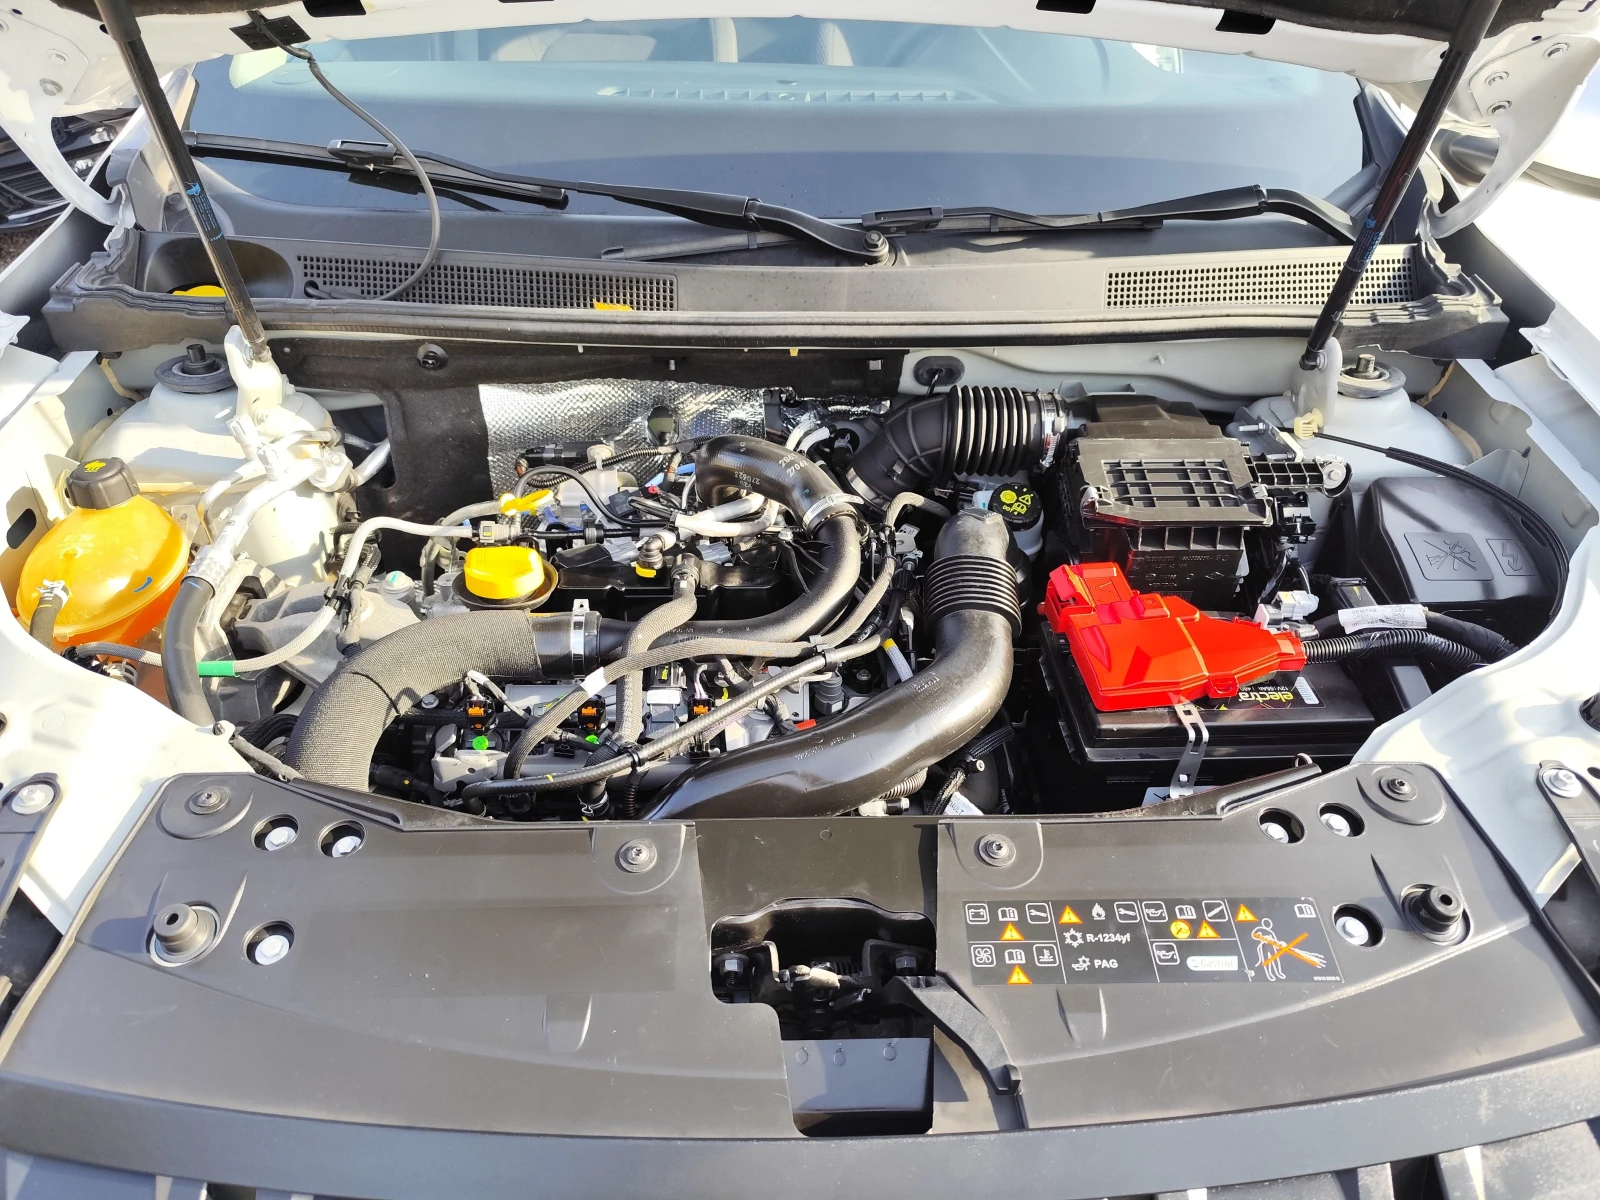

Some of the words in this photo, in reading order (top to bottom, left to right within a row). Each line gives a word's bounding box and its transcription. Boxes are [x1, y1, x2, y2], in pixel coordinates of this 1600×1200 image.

[1002, 504, 1014, 513] DOT
[1239, 690, 1294, 702] electra
[1085, 932, 1131, 945] R-1234yf
[1094, 958, 1119, 969] PAG
[1201, 957, 1234, 968] Castrol
